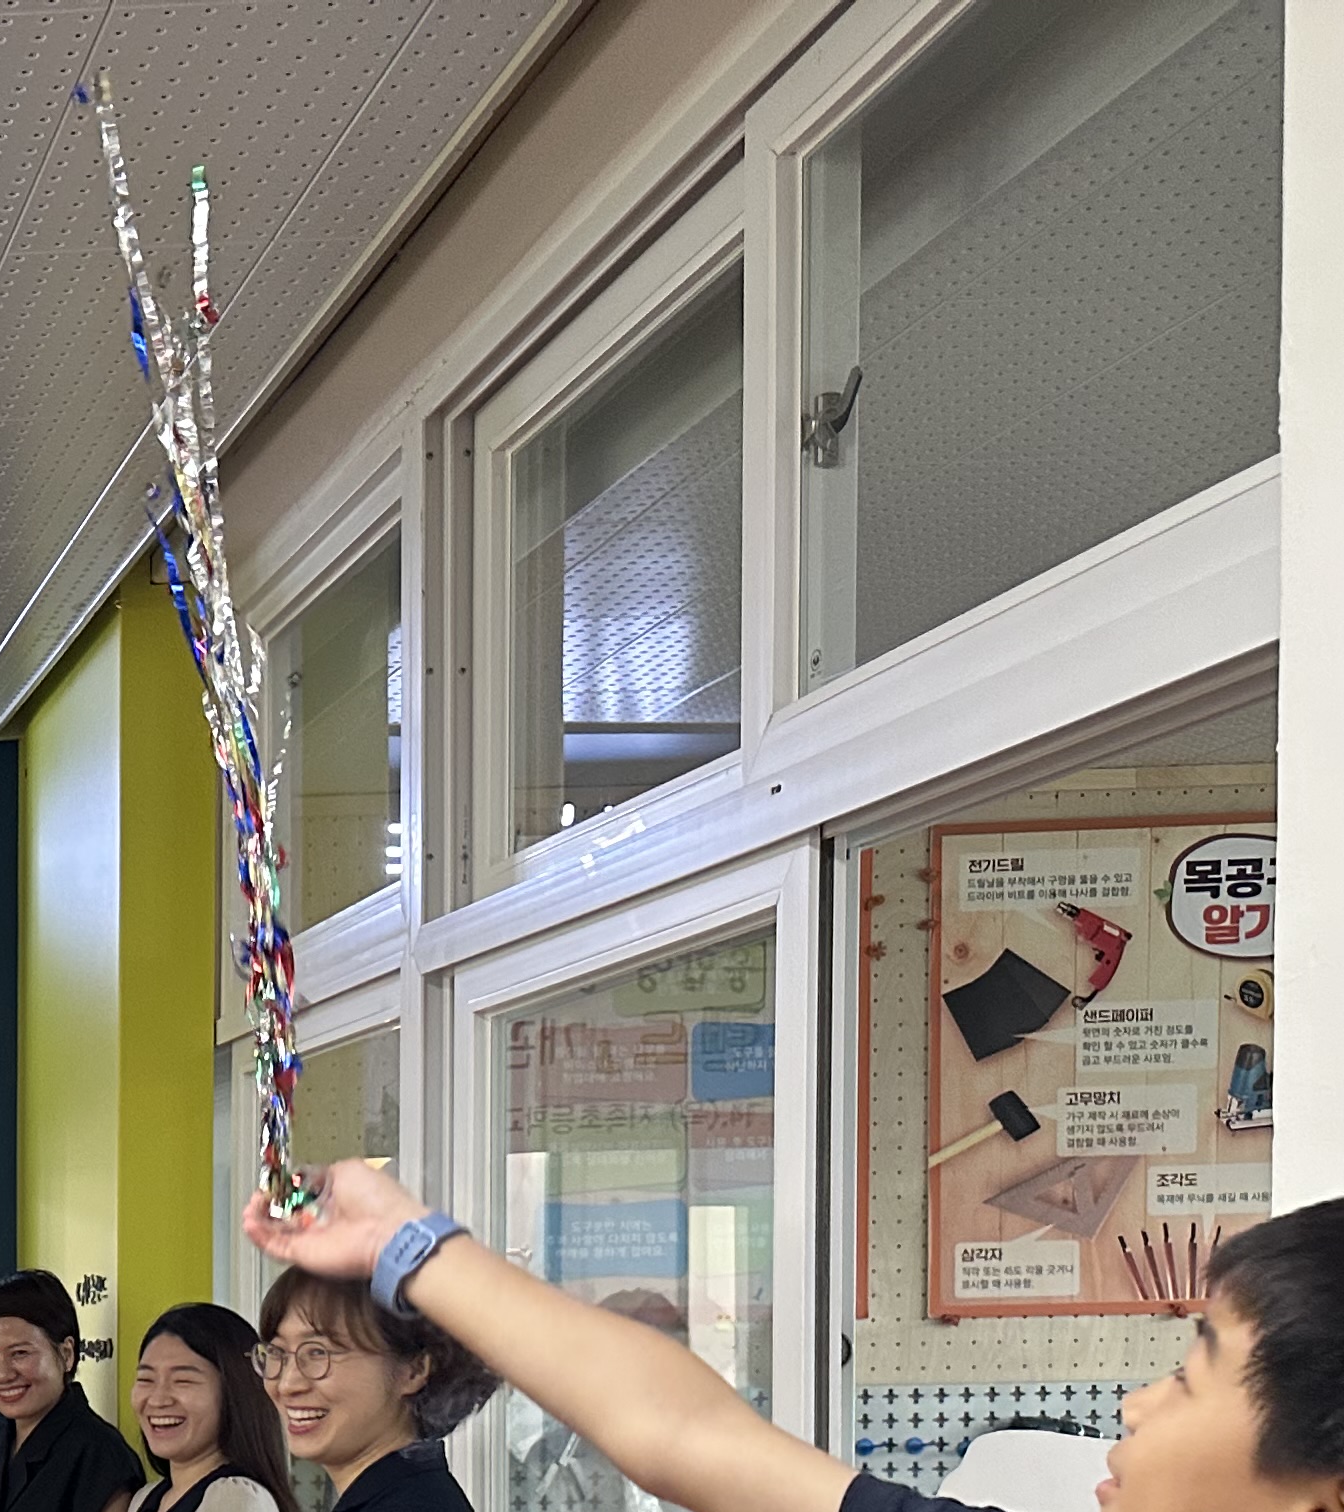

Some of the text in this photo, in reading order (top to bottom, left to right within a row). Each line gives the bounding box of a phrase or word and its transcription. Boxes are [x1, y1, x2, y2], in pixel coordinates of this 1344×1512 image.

[968, 858, 1024, 873] 전기드릴
[1083, 1008, 1154, 1023] 샌드페이퍼
[1065, 1091, 1121, 1106] 고무망치
[1156, 1173, 1198, 1187] 조각도
[961, 1248, 1002, 1262] 삼각자
